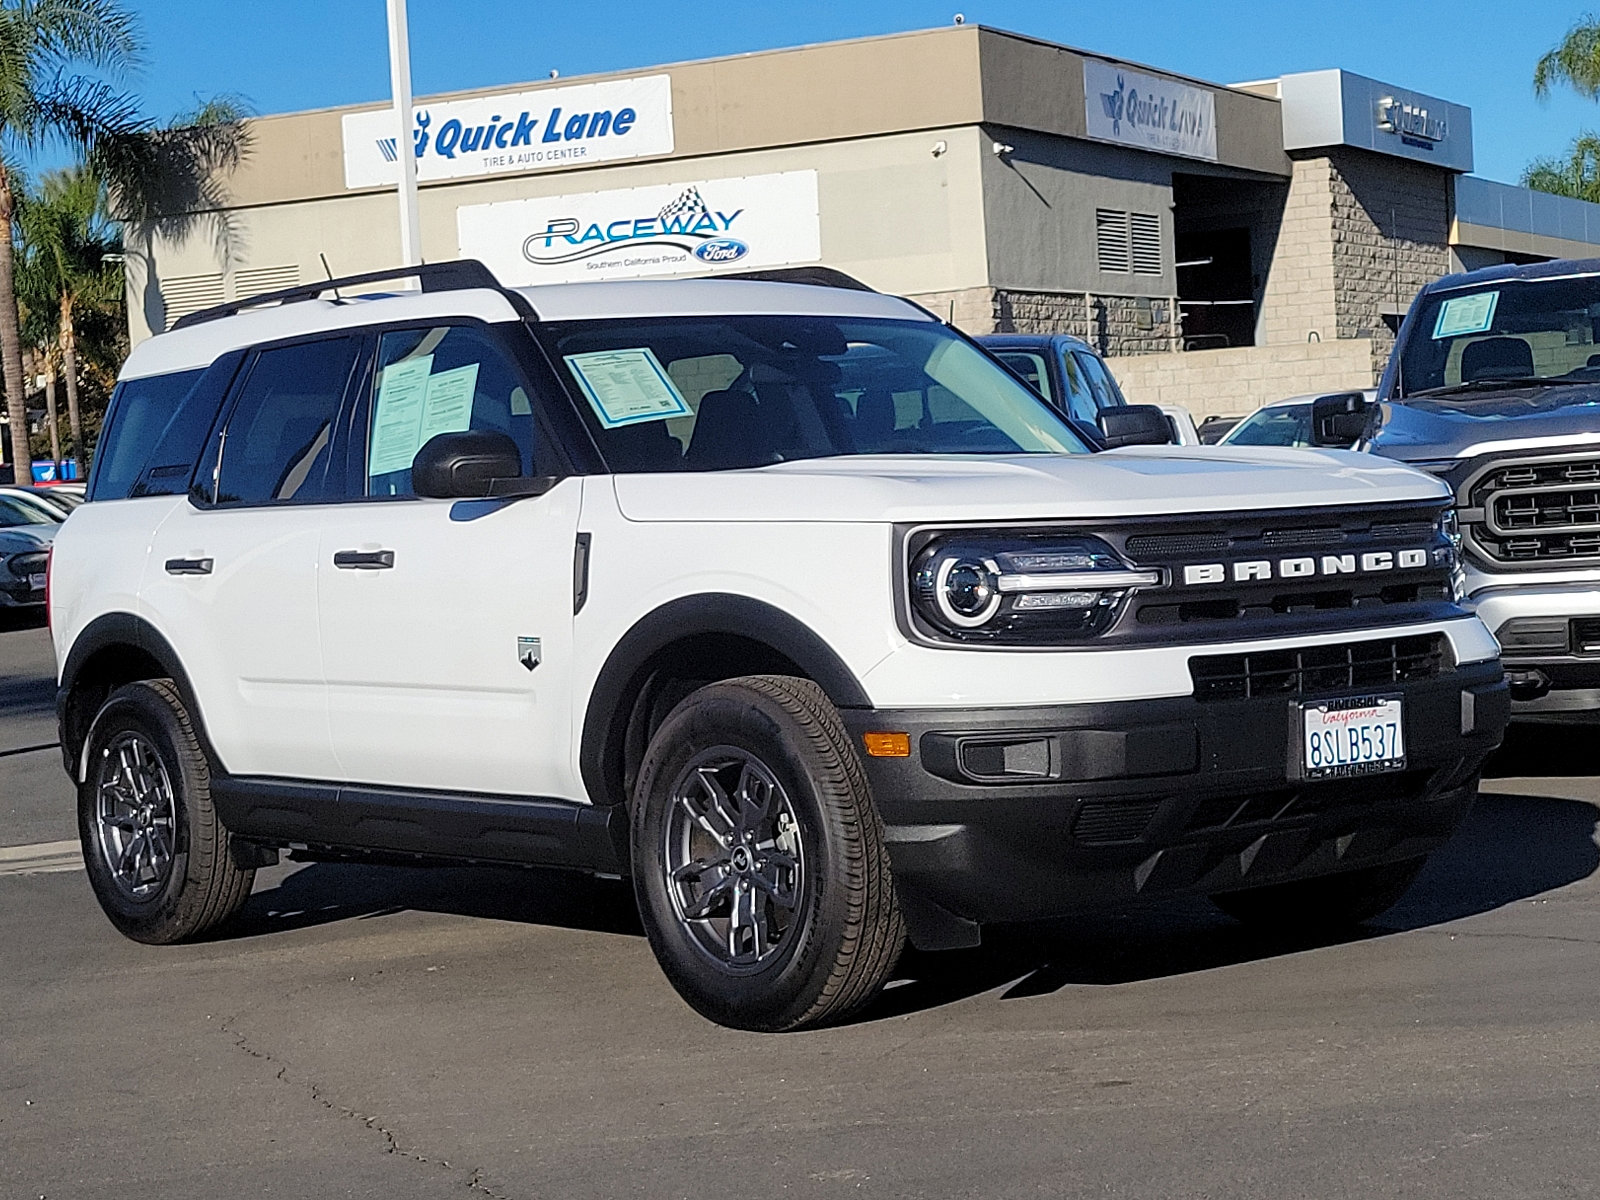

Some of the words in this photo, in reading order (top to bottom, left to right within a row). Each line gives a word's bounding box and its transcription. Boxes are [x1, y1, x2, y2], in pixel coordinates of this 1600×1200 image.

[435, 111, 539, 159] Quick
[542, 107, 636, 143] Lane
[483, 155, 505, 168] TIRE
[508, 155, 515, 165] &
[517, 152, 544, 164] AUTO
[547, 147, 587, 161] CENTER
[545, 209, 745, 247] RACEWAY
[586, 260, 622, 271] Southern
[624, 257, 660, 268] California
[662, 254, 686, 264] Proud
[702, 242, 738, 260] Ford
[1184, 549, 1427, 585] BRONCO
[1322, 708, 1379, 727] California
[1310, 722, 1397, 767] 8SLB537
